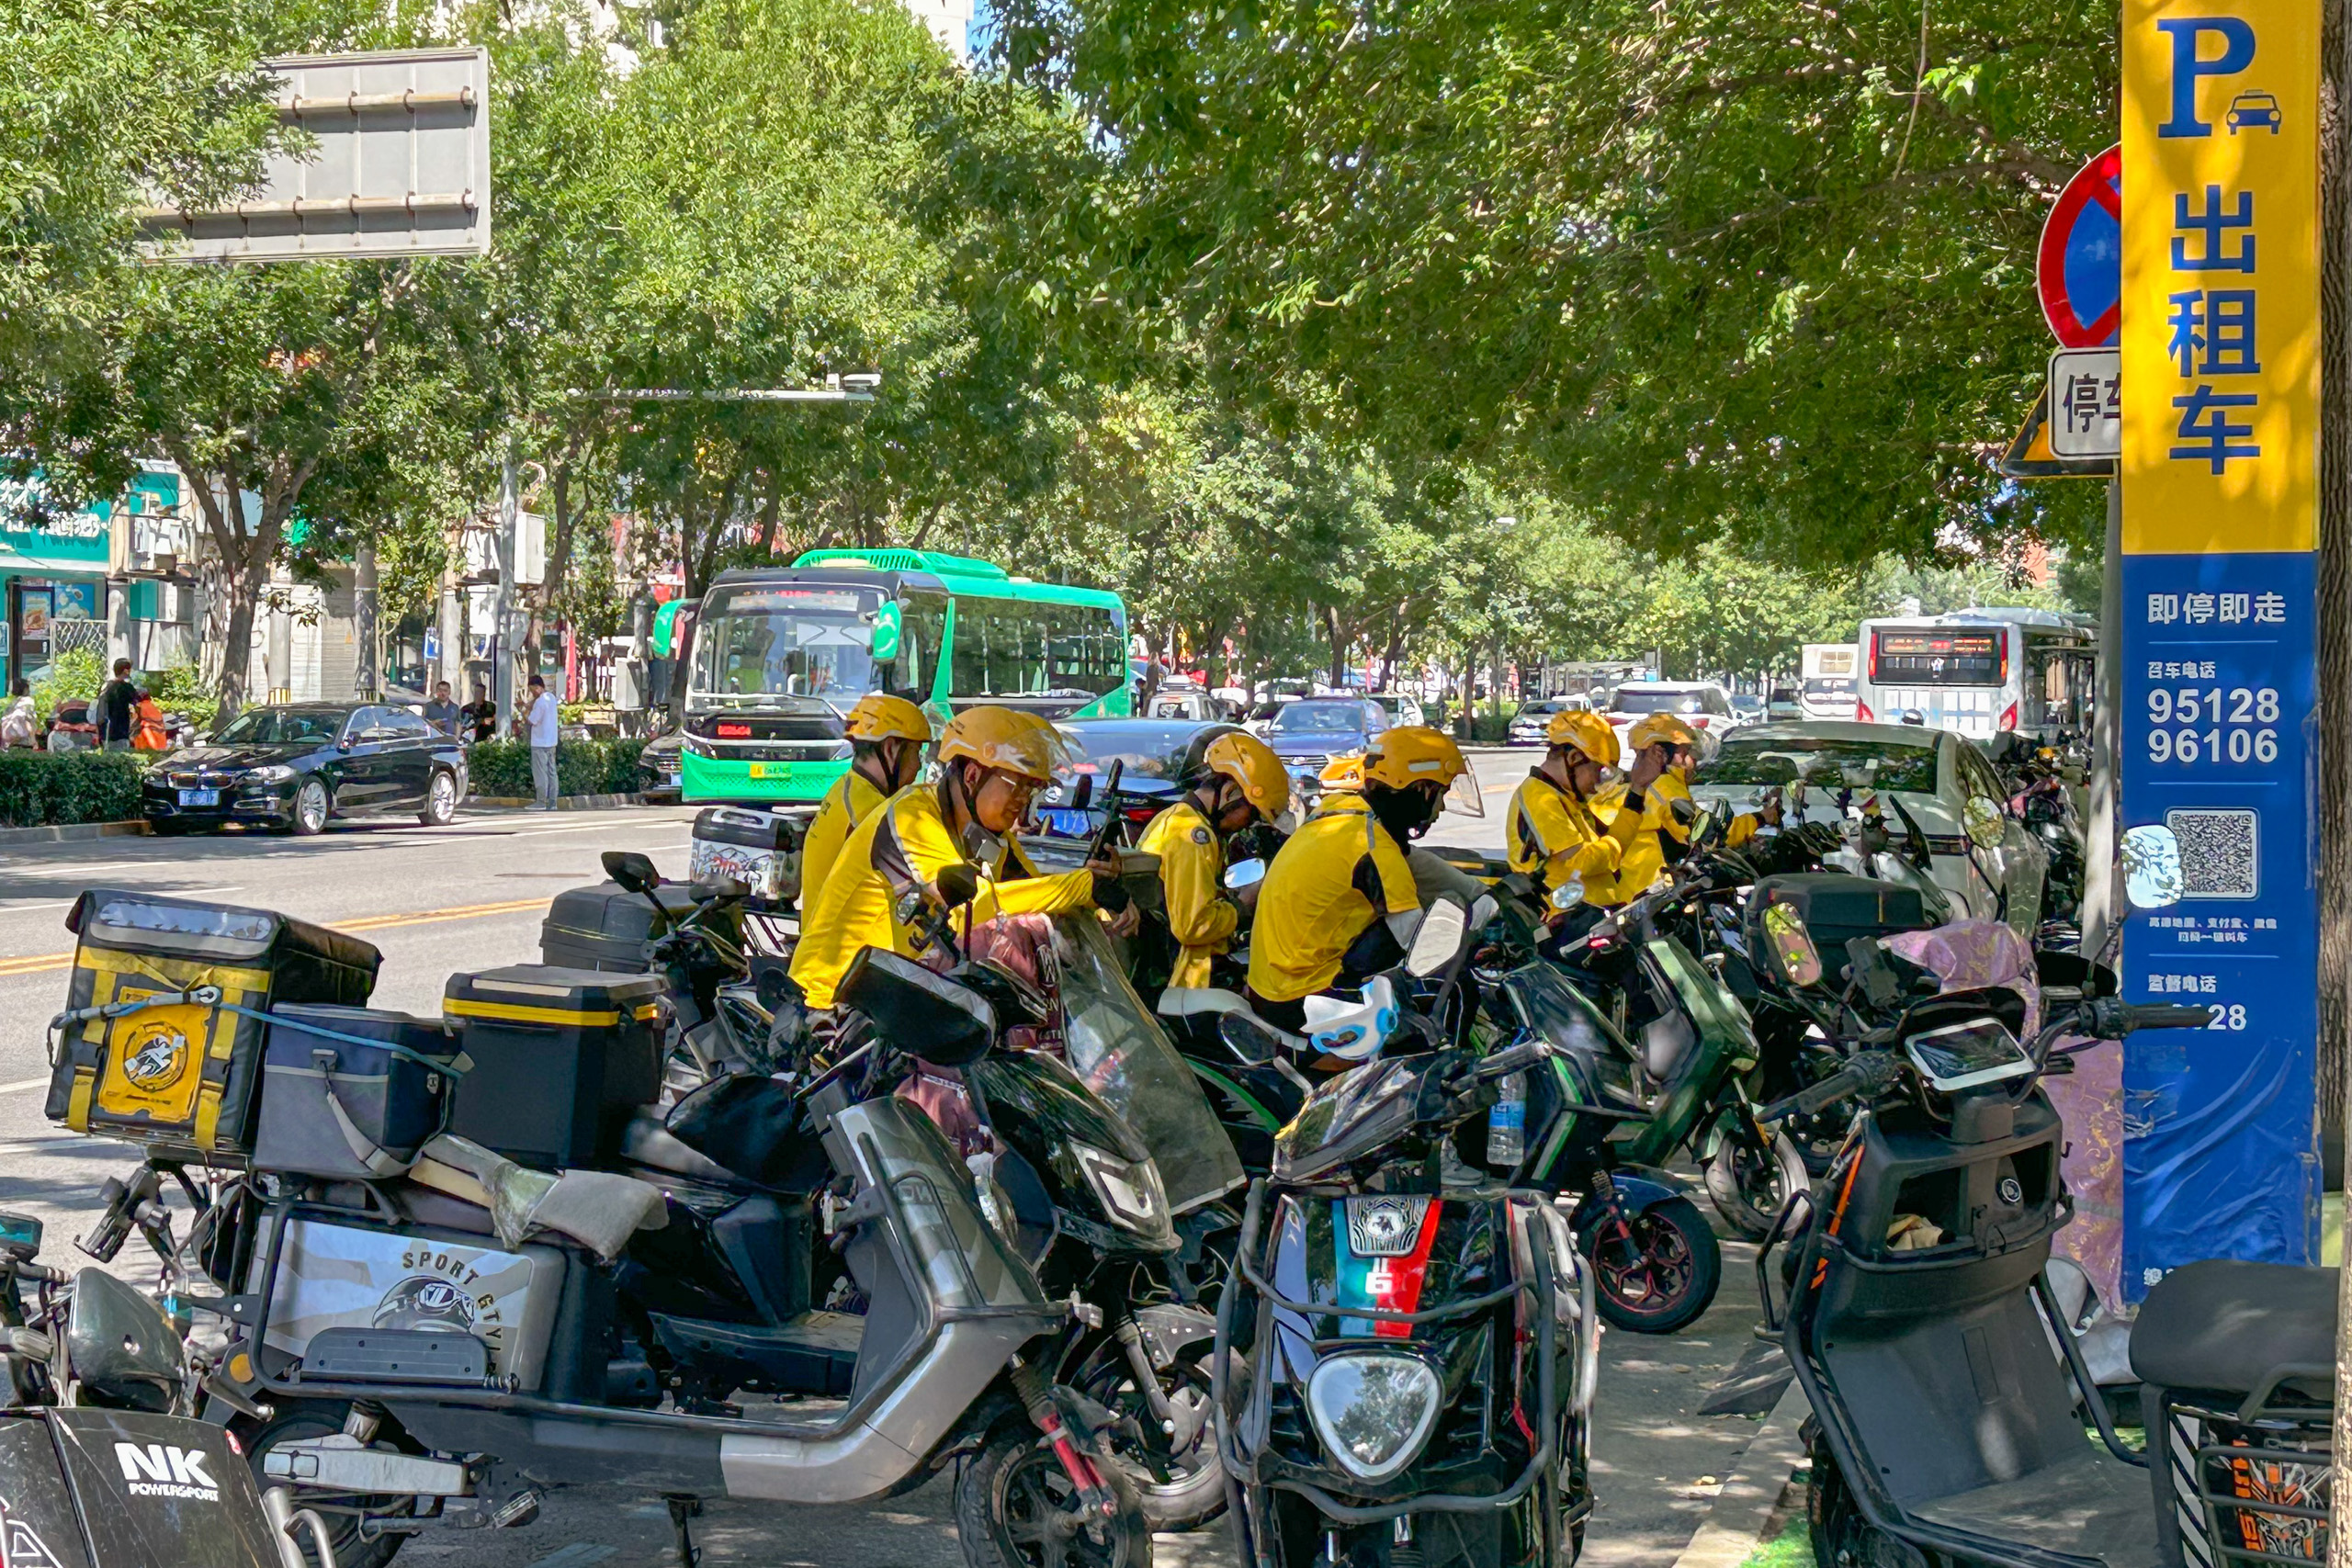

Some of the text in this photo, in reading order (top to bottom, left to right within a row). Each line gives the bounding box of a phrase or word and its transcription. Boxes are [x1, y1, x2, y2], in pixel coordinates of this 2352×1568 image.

[2156, 17, 2256, 138] P
[2168, 185, 2261, 475] 出租车
[2147, 592, 2286, 625] 即停即走
[2148, 660, 2216, 679] 召车电话
[2147, 687, 2280, 724] 95128
[2147, 728, 2278, 763] 96106
[402, 1251, 479, 1285] SPORT
[114, 1442, 219, 1488] NK
[129, 1482, 220, 1503] POWERSPORT
